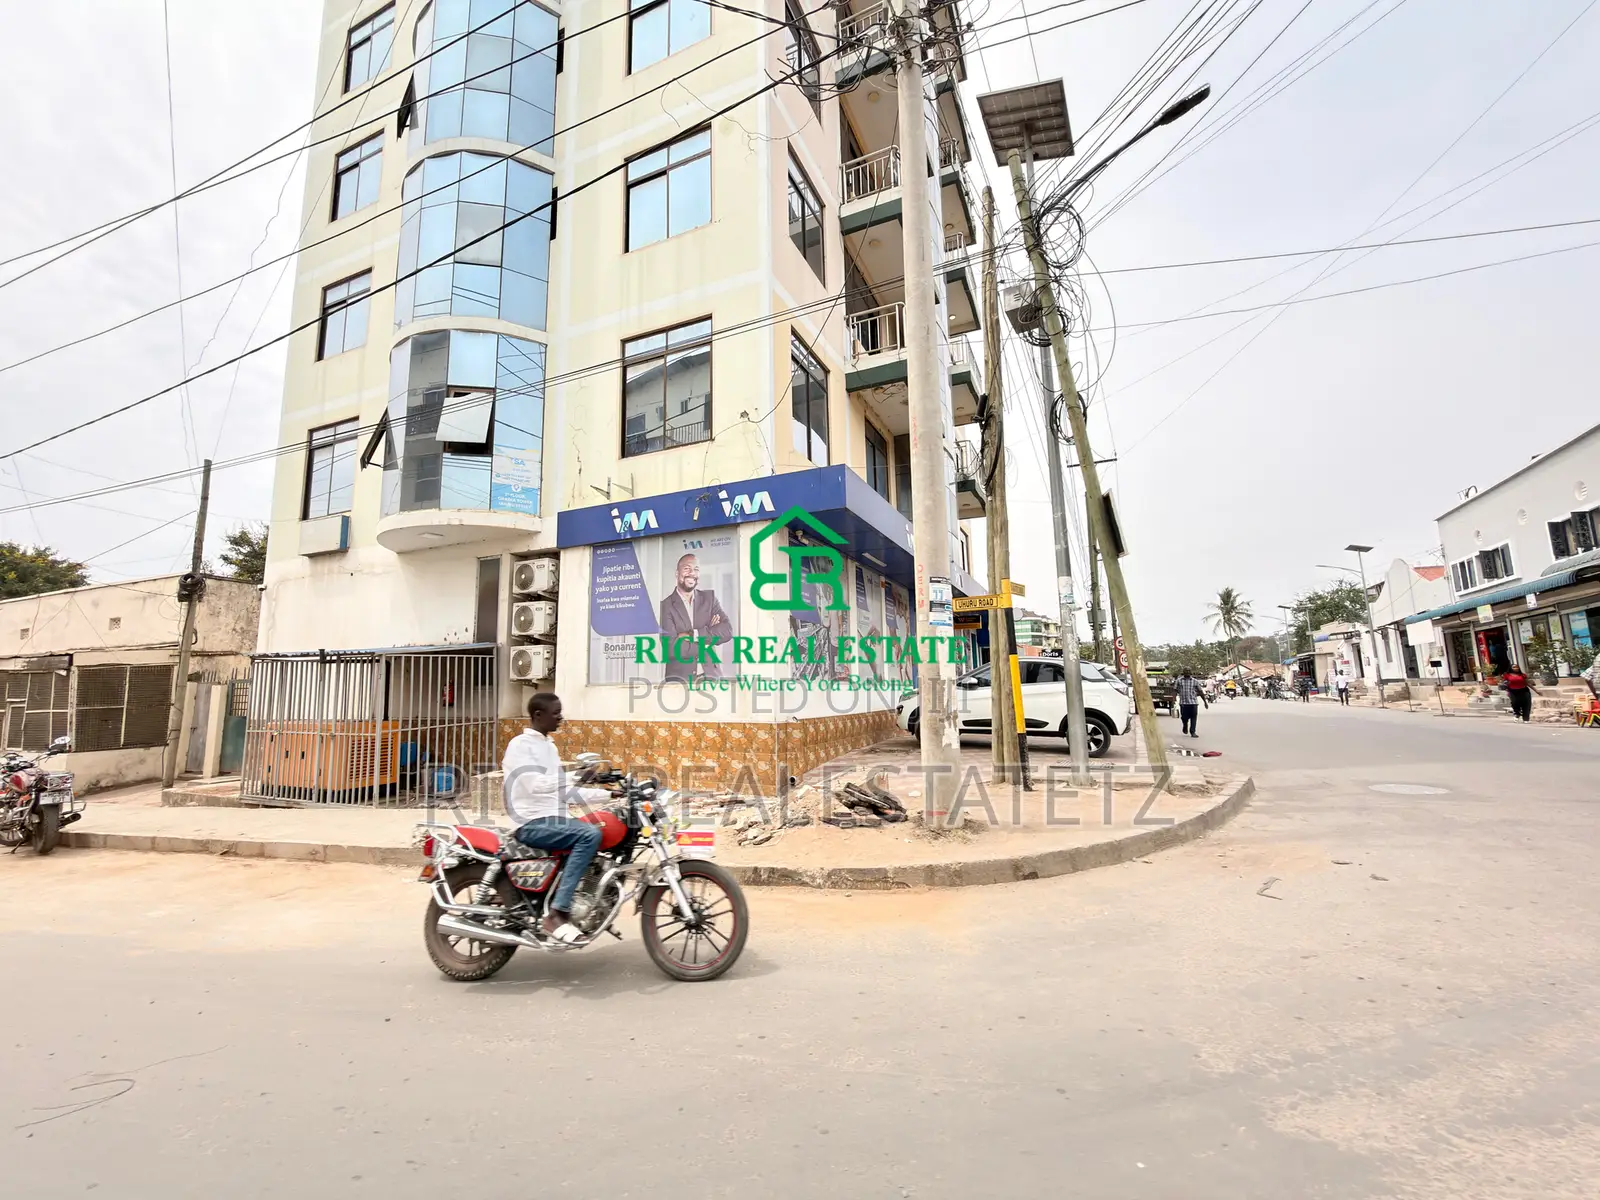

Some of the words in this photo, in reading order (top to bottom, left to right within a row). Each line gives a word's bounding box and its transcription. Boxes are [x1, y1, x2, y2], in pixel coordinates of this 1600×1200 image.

[602, 564, 622, 575] Jipatie
[622, 563, 635, 571] riba
[596, 575, 617, 584] kupitia
[617, 572, 641, 581] akaunti
[595, 586, 610, 595] yako
[610, 584, 618, 593] ya
[618, 582, 642, 590] current
[958, 600, 978, 609] UHURU
[978, 598, 994, 607] ROAD
[604, 643, 637, 652] Bonanz
